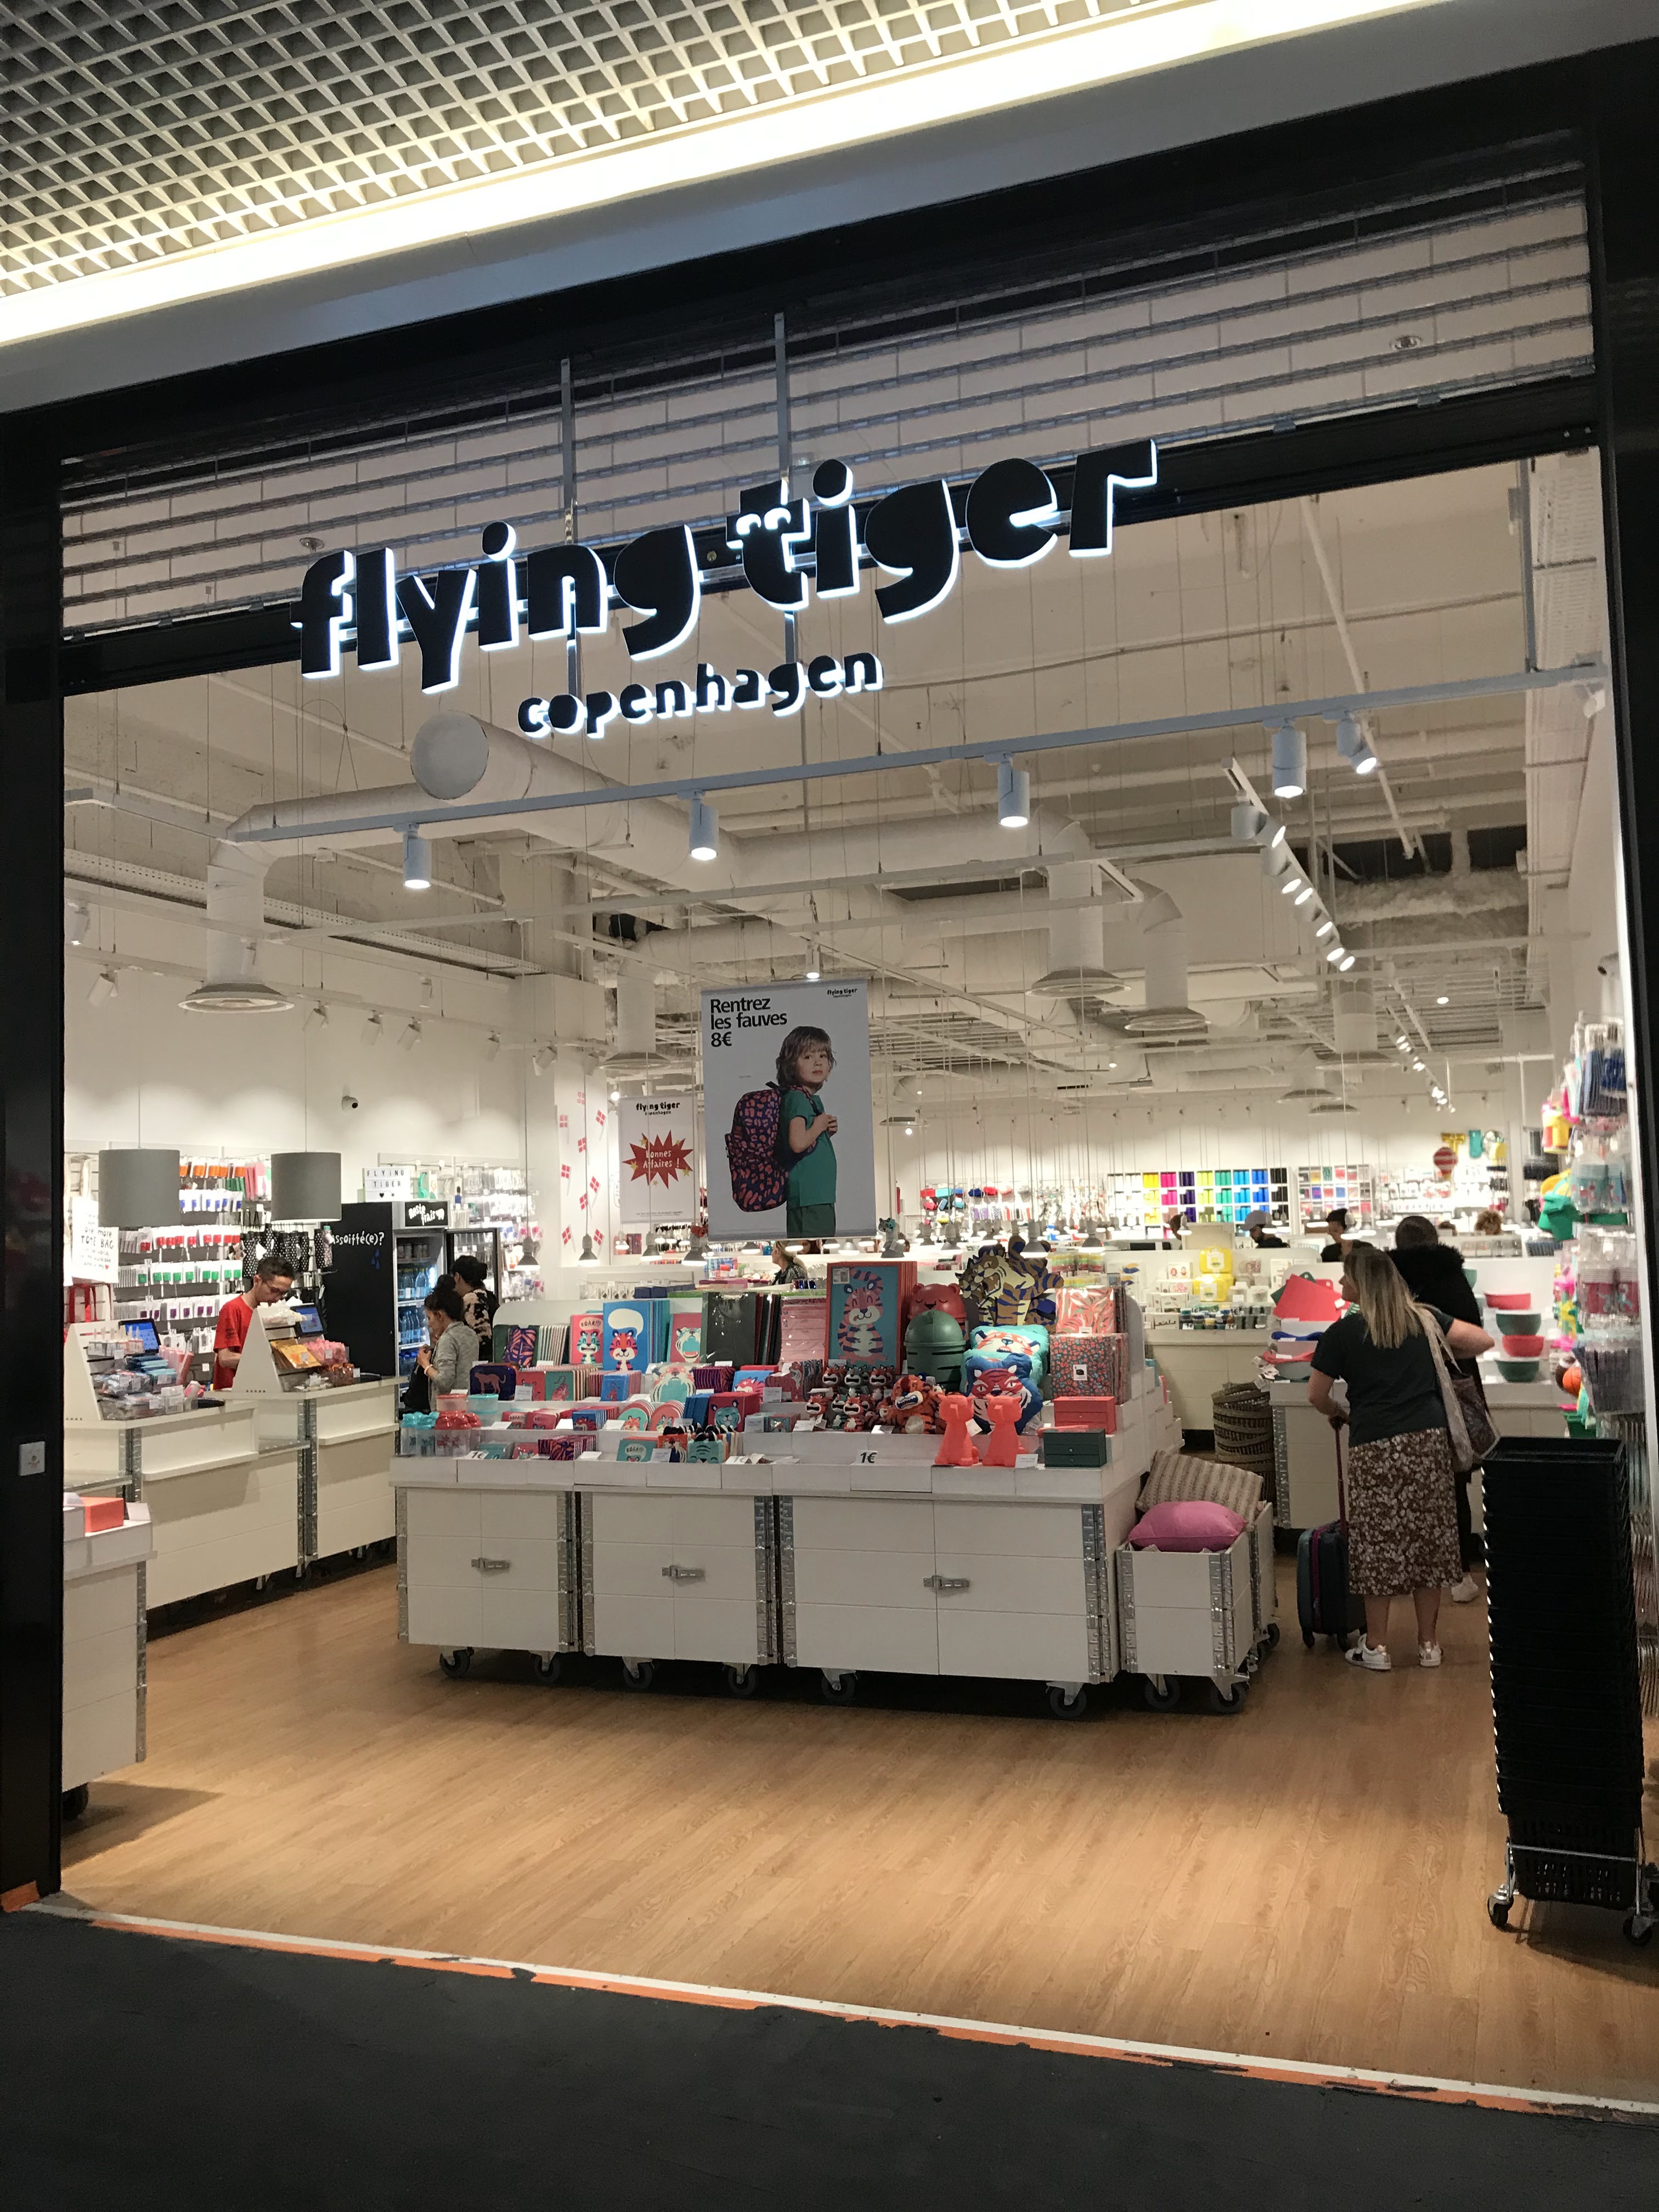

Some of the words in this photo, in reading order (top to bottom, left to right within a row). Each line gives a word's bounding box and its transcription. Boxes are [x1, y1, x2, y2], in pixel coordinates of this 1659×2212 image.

[290, 521, 701, 694] flying
[726, 439, 1158, 624] tiger
[518, 653, 884, 739] copenhagen
[710, 997, 771, 1013] Rentrez
[710, 1013, 732, 1030] les
[736, 1012, 787, 1028] fauves
[711, 1031, 732, 1047] 8€
[659, 1102, 680, 1110] tiger
[81, 1235, 96, 1246] TOTE
[101, 1239, 114, 1249] BAG
[861, 1452, 877, 1463] 1€
